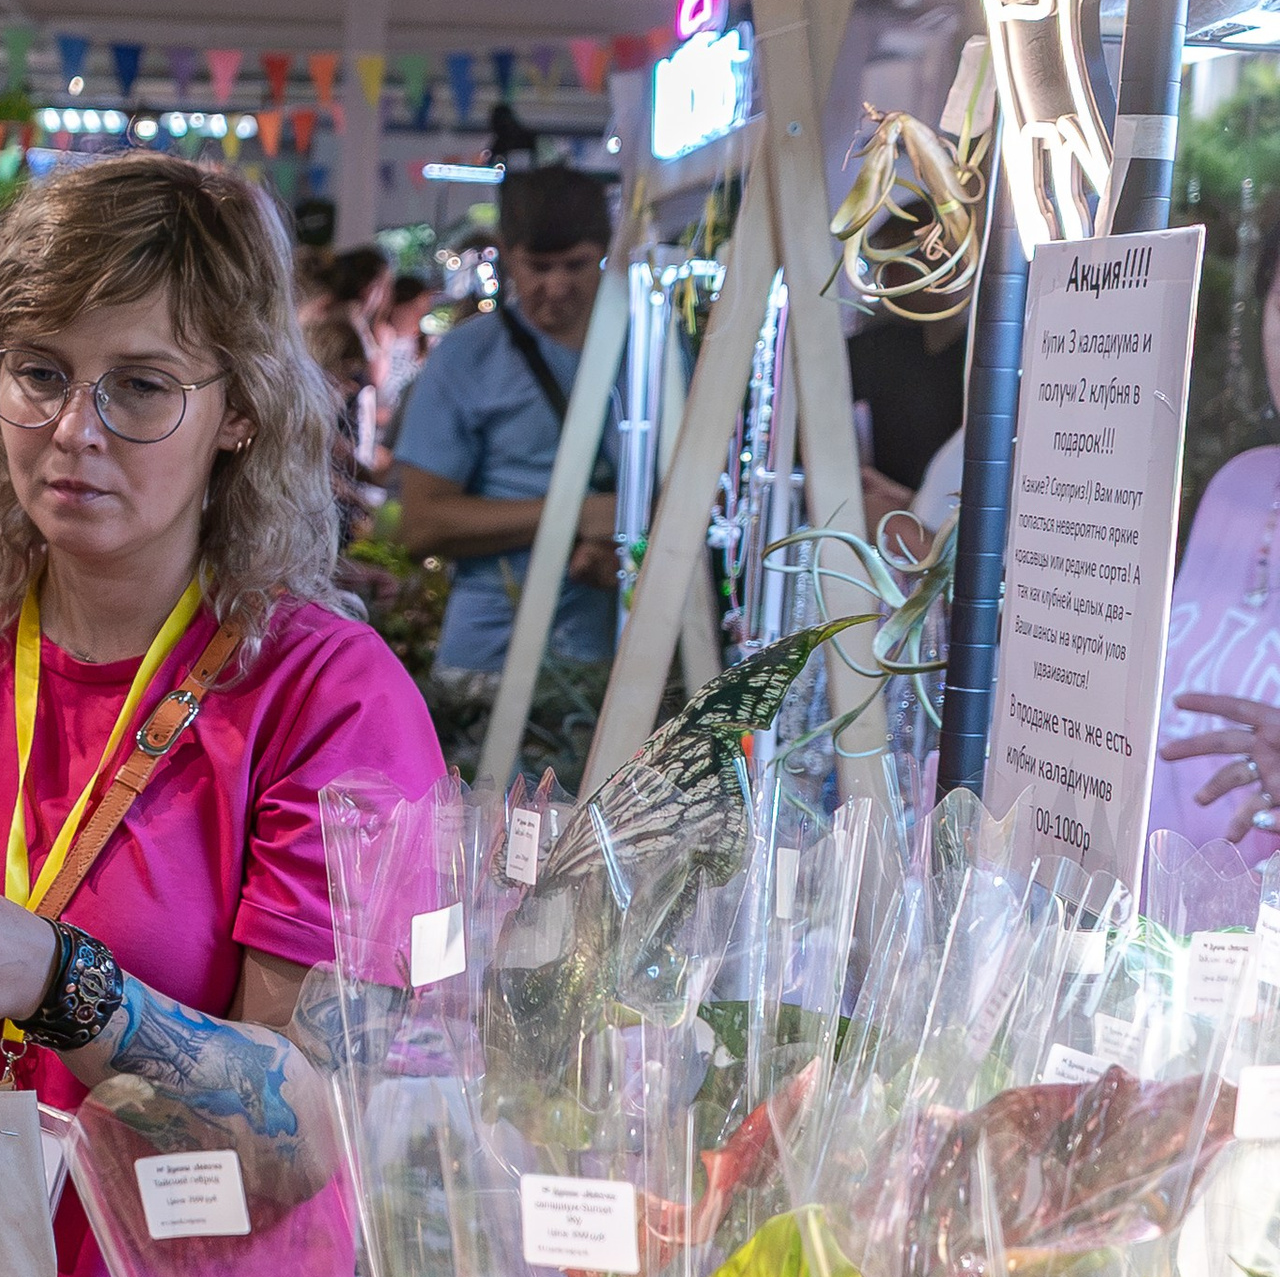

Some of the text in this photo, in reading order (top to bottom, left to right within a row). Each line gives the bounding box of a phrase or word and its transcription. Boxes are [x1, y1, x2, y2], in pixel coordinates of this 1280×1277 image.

[1065, 246, 1152, 299] Акция!!!!
[1042, 329, 1153, 360] Купи 3 каладиума и
[1038, 376, 1141, 410] получи 2 клубня в
[1053, 427, 1116, 458] подарок!!!
[1022, 474, 1050, 495] Какие?
[1094, 482, 1113, 503] Вам
[1114, 488, 1144, 510] могут
[1055, 519, 1108, 541] невероятно
[1108, 526, 1139, 548] яркие
[1050, 554, 1065, 570] или
[1065, 557, 1097, 579] редкие
[1099, 562, 1132, 585] сорта!
[1132, 565, 1141, 585] А
[1073, 596, 1103, 616] целых
[1104, 603, 1124, 623] два
[1058, 630, 1071, 647] на
[1071, 633, 1104, 656] крутой
[1104, 641, 1127, 661] улов
[1010, 693, 1133, 757] В продаже так же есть
[1006, 744, 1113, 802] клубни каладиумов
